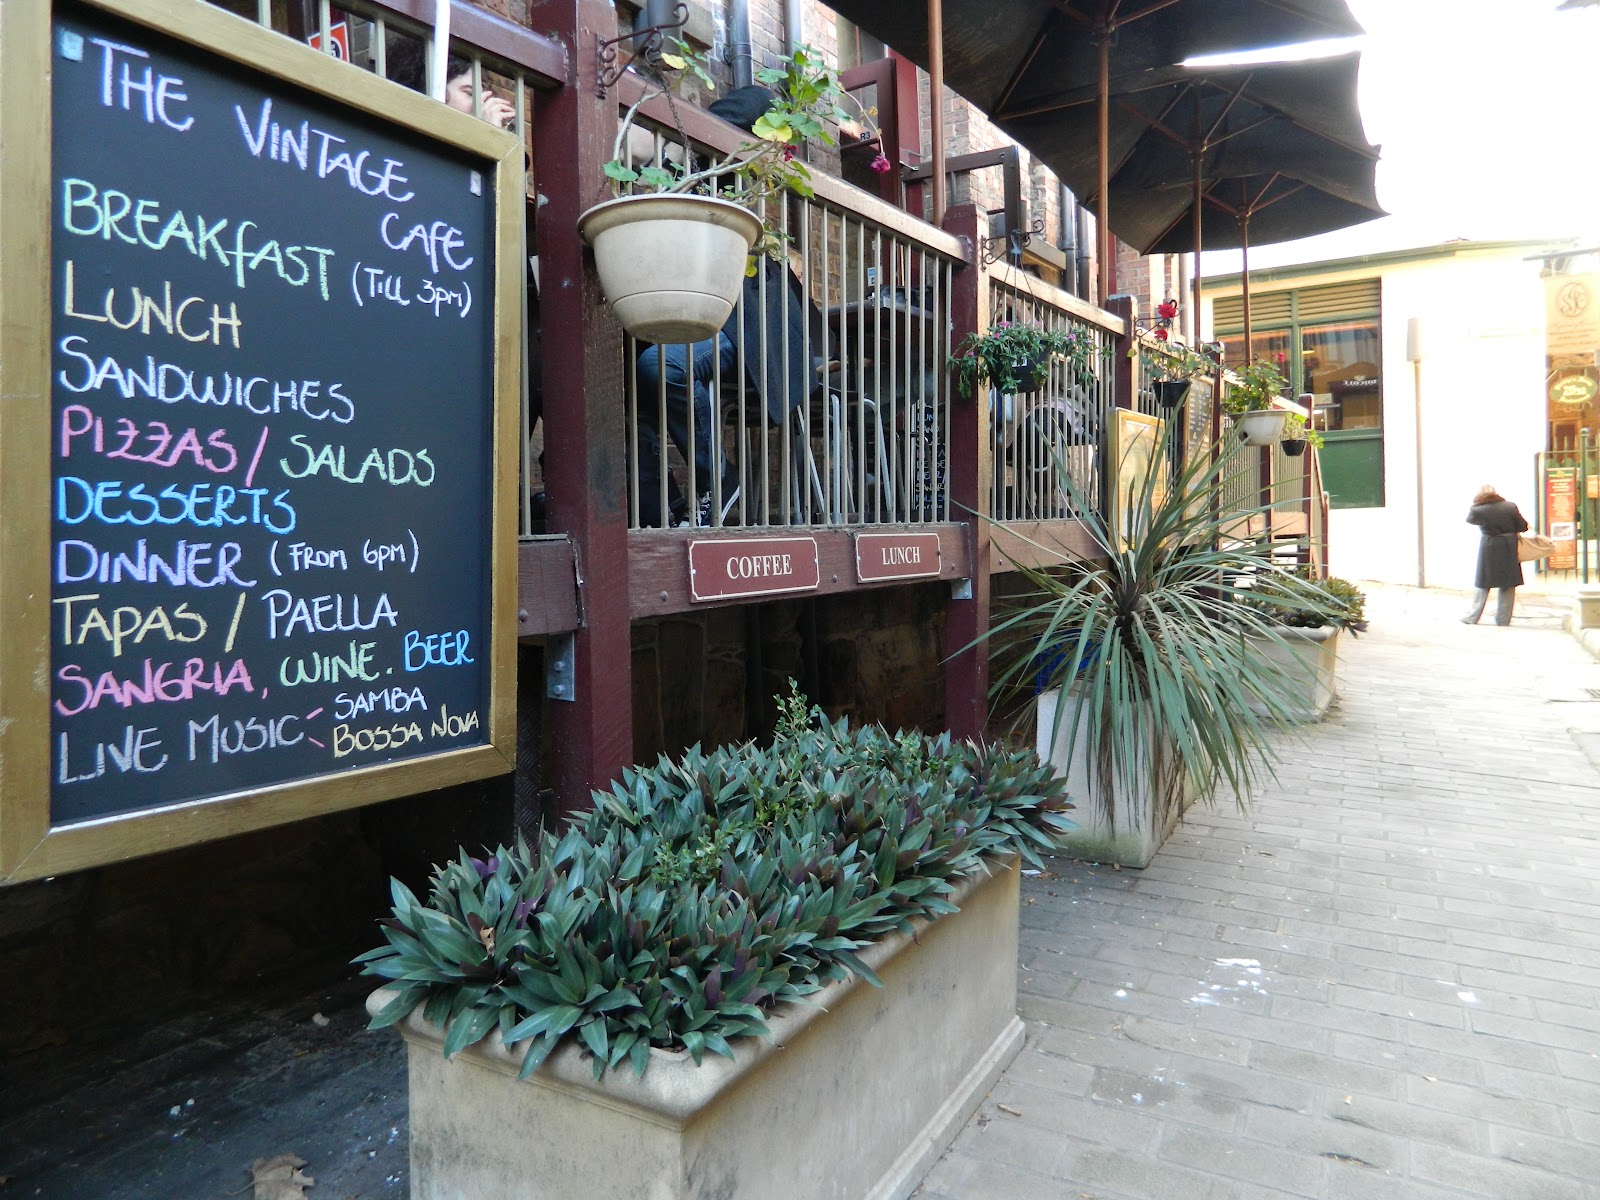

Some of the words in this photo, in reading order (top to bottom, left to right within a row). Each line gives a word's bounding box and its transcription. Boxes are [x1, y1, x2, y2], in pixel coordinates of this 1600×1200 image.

[89, 38, 196, 133] THE
[233, 98, 416, 204] VINTAGE
[64, 260, 243, 349] LUNCH
[58, 334, 355, 424] SANDWICHES
[60, 404, 239, 473] PIZZAS
[280, 434, 436, 487] SALADS
[57, 476, 297, 535] DESSERTS
[57, 539, 258, 588] DINNER
[726, 554, 793, 580] COFFEE
[881, 546, 921, 565] LUNCH
[53, 592, 209, 658] TAPAS
[262, 589, 399, 640] PAELLA
[403, 629, 475, 672] BEER
[333, 686, 428, 720] SAMBA
[333, 721, 424, 758] BOSSA
[430, 703, 480, 738] NOVA
[58, 724, 169, 785] LIVE
[188, 714, 305, 764] MUSIC
